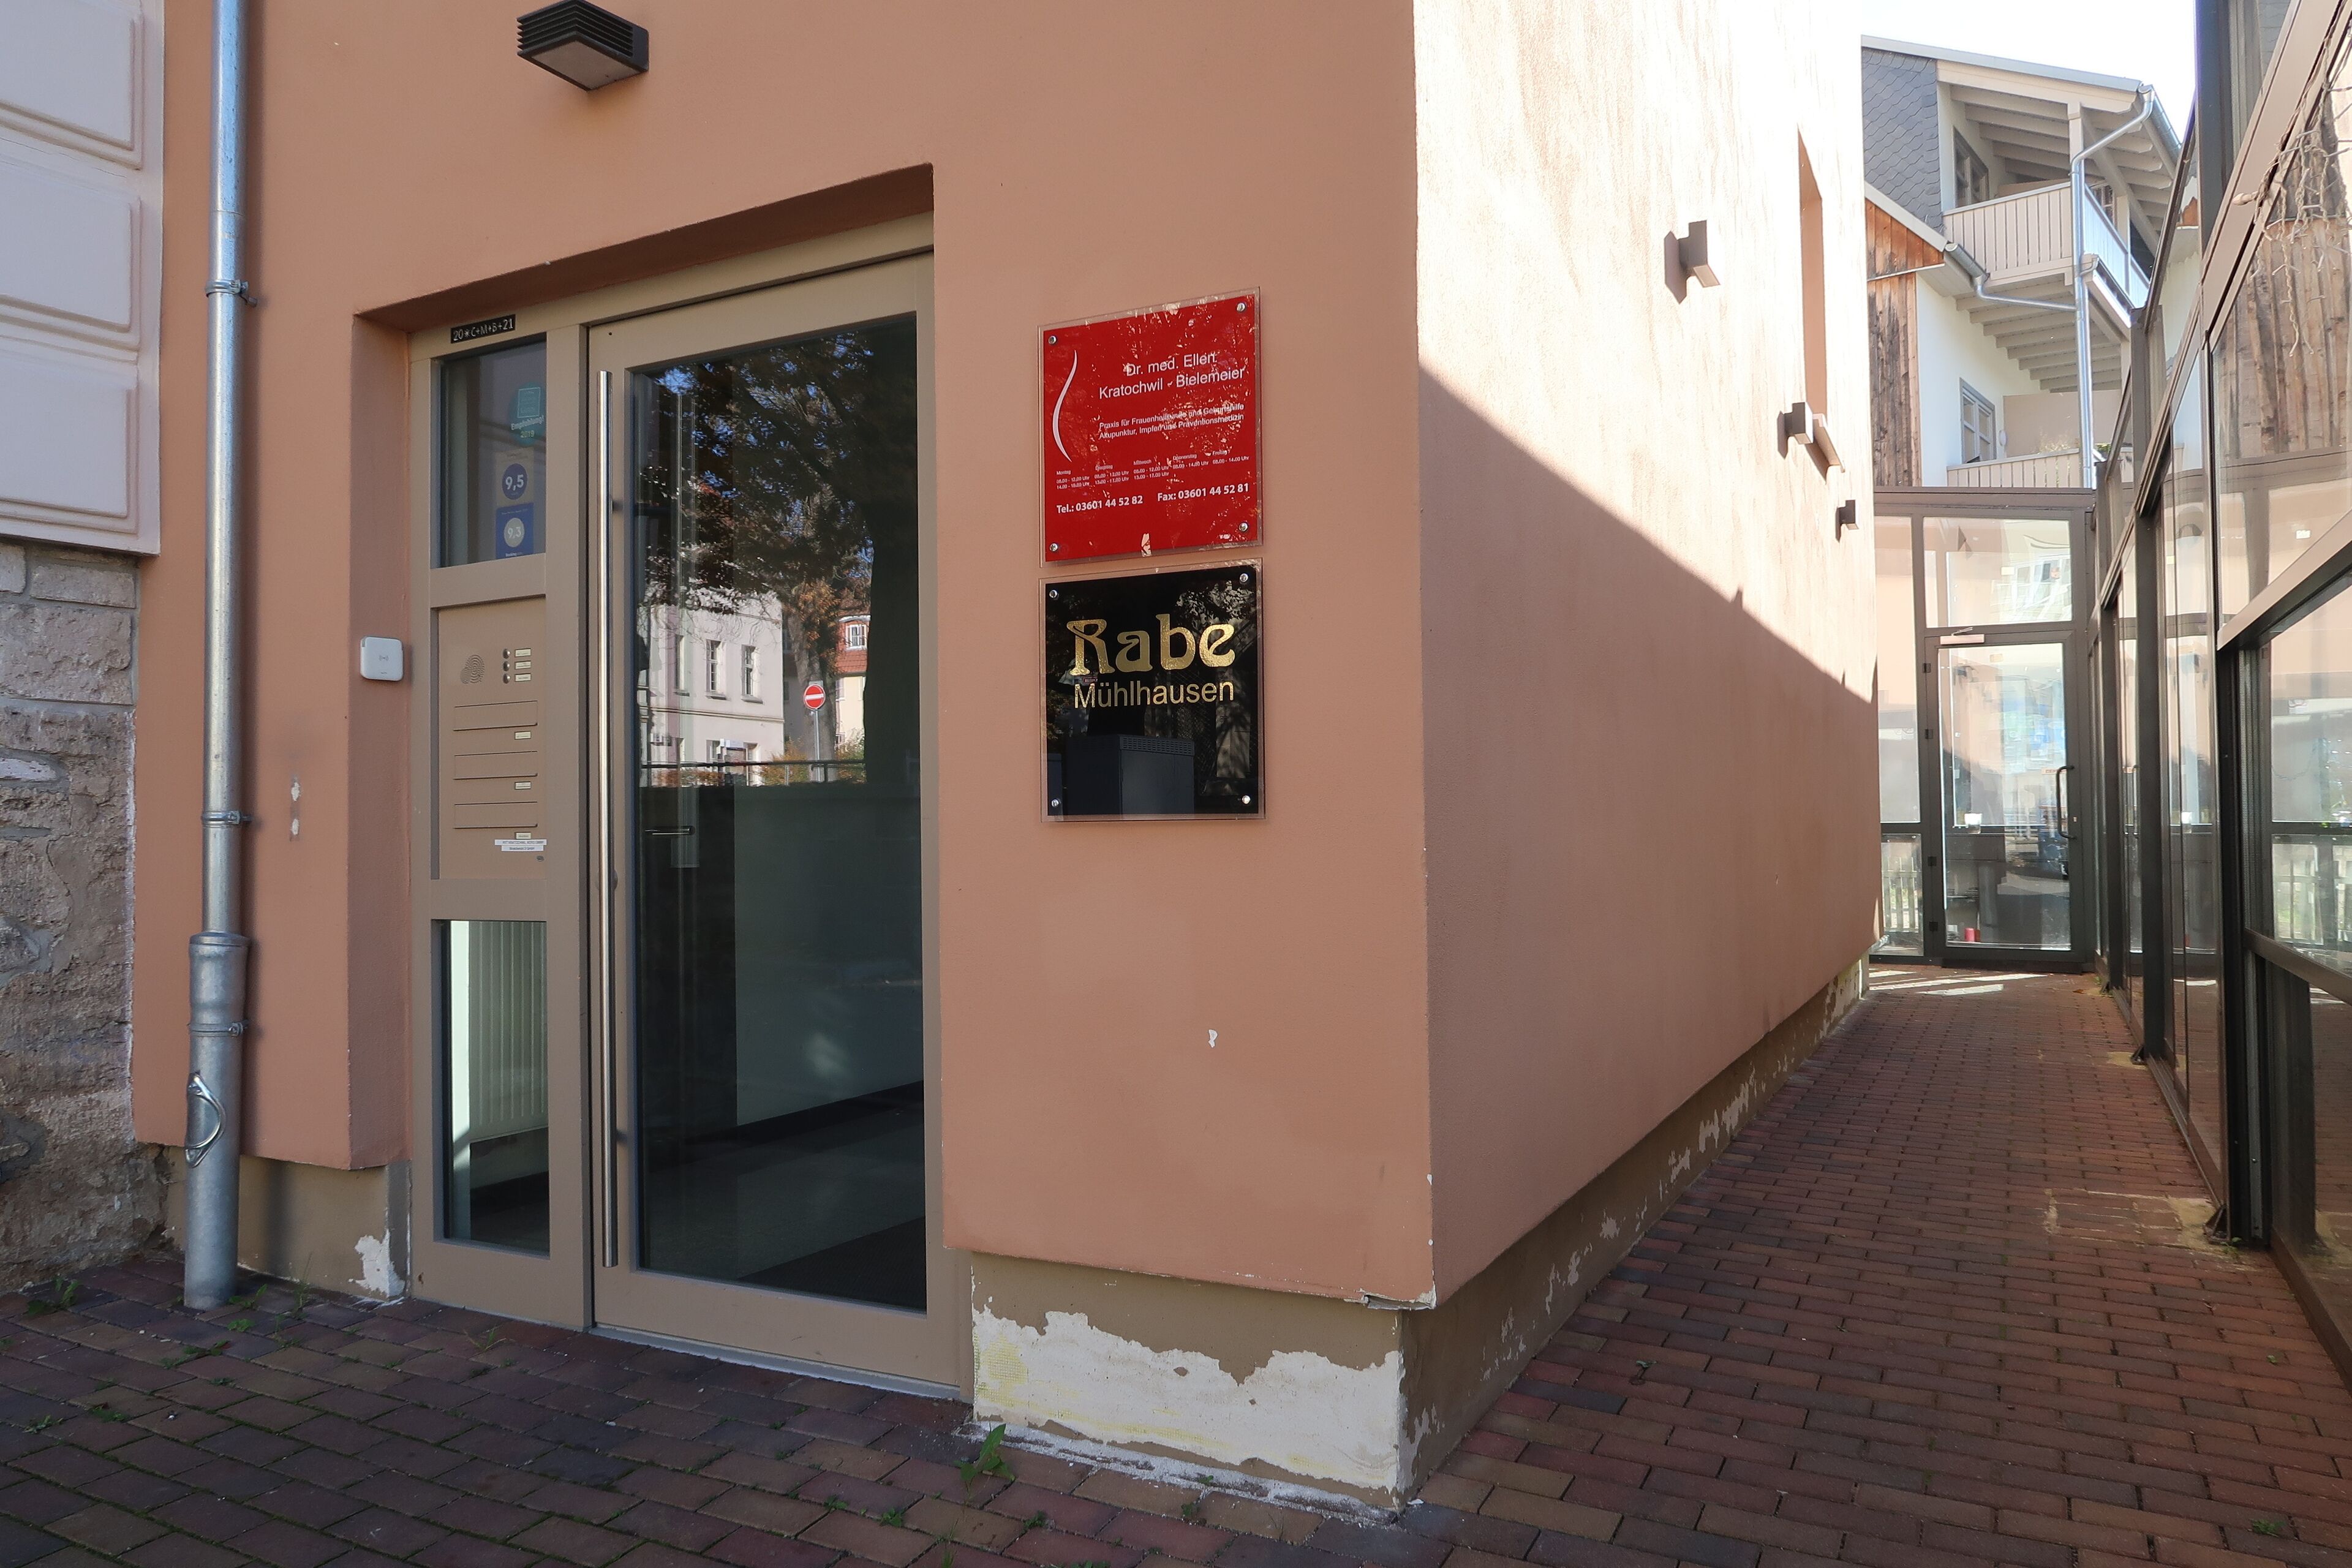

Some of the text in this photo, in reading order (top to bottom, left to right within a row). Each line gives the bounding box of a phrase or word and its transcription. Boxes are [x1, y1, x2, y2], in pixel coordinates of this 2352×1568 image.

[1126, 353, 1215, 376] Dr. med. Ellen
[1099, 378, 1163, 399] Kratochwil
[1176, 367, 1245, 388] Bielemeier
[1099, 421, 1120, 430] Praxis
[1131, 411, 1186, 425] Frauenheilkunde
[1204, 402, 1245, 415] Geburtshilfe
[1099, 429, 1137, 440] Akupunktur,
[1139, 424, 1162, 433] Impfen
[1178, 413, 1244, 428] Präventionsmedizin
[505, 474, 524, 491] 9,5
[1158, 483, 1249, 502] Fax: 03601 44 52 81
[1057, 495, 1144, 513] Tel.: 03601 44 52 82
[1066, 614, 1235, 676] Rabe
[1074, 680, 1234, 709] Mühlhausen
